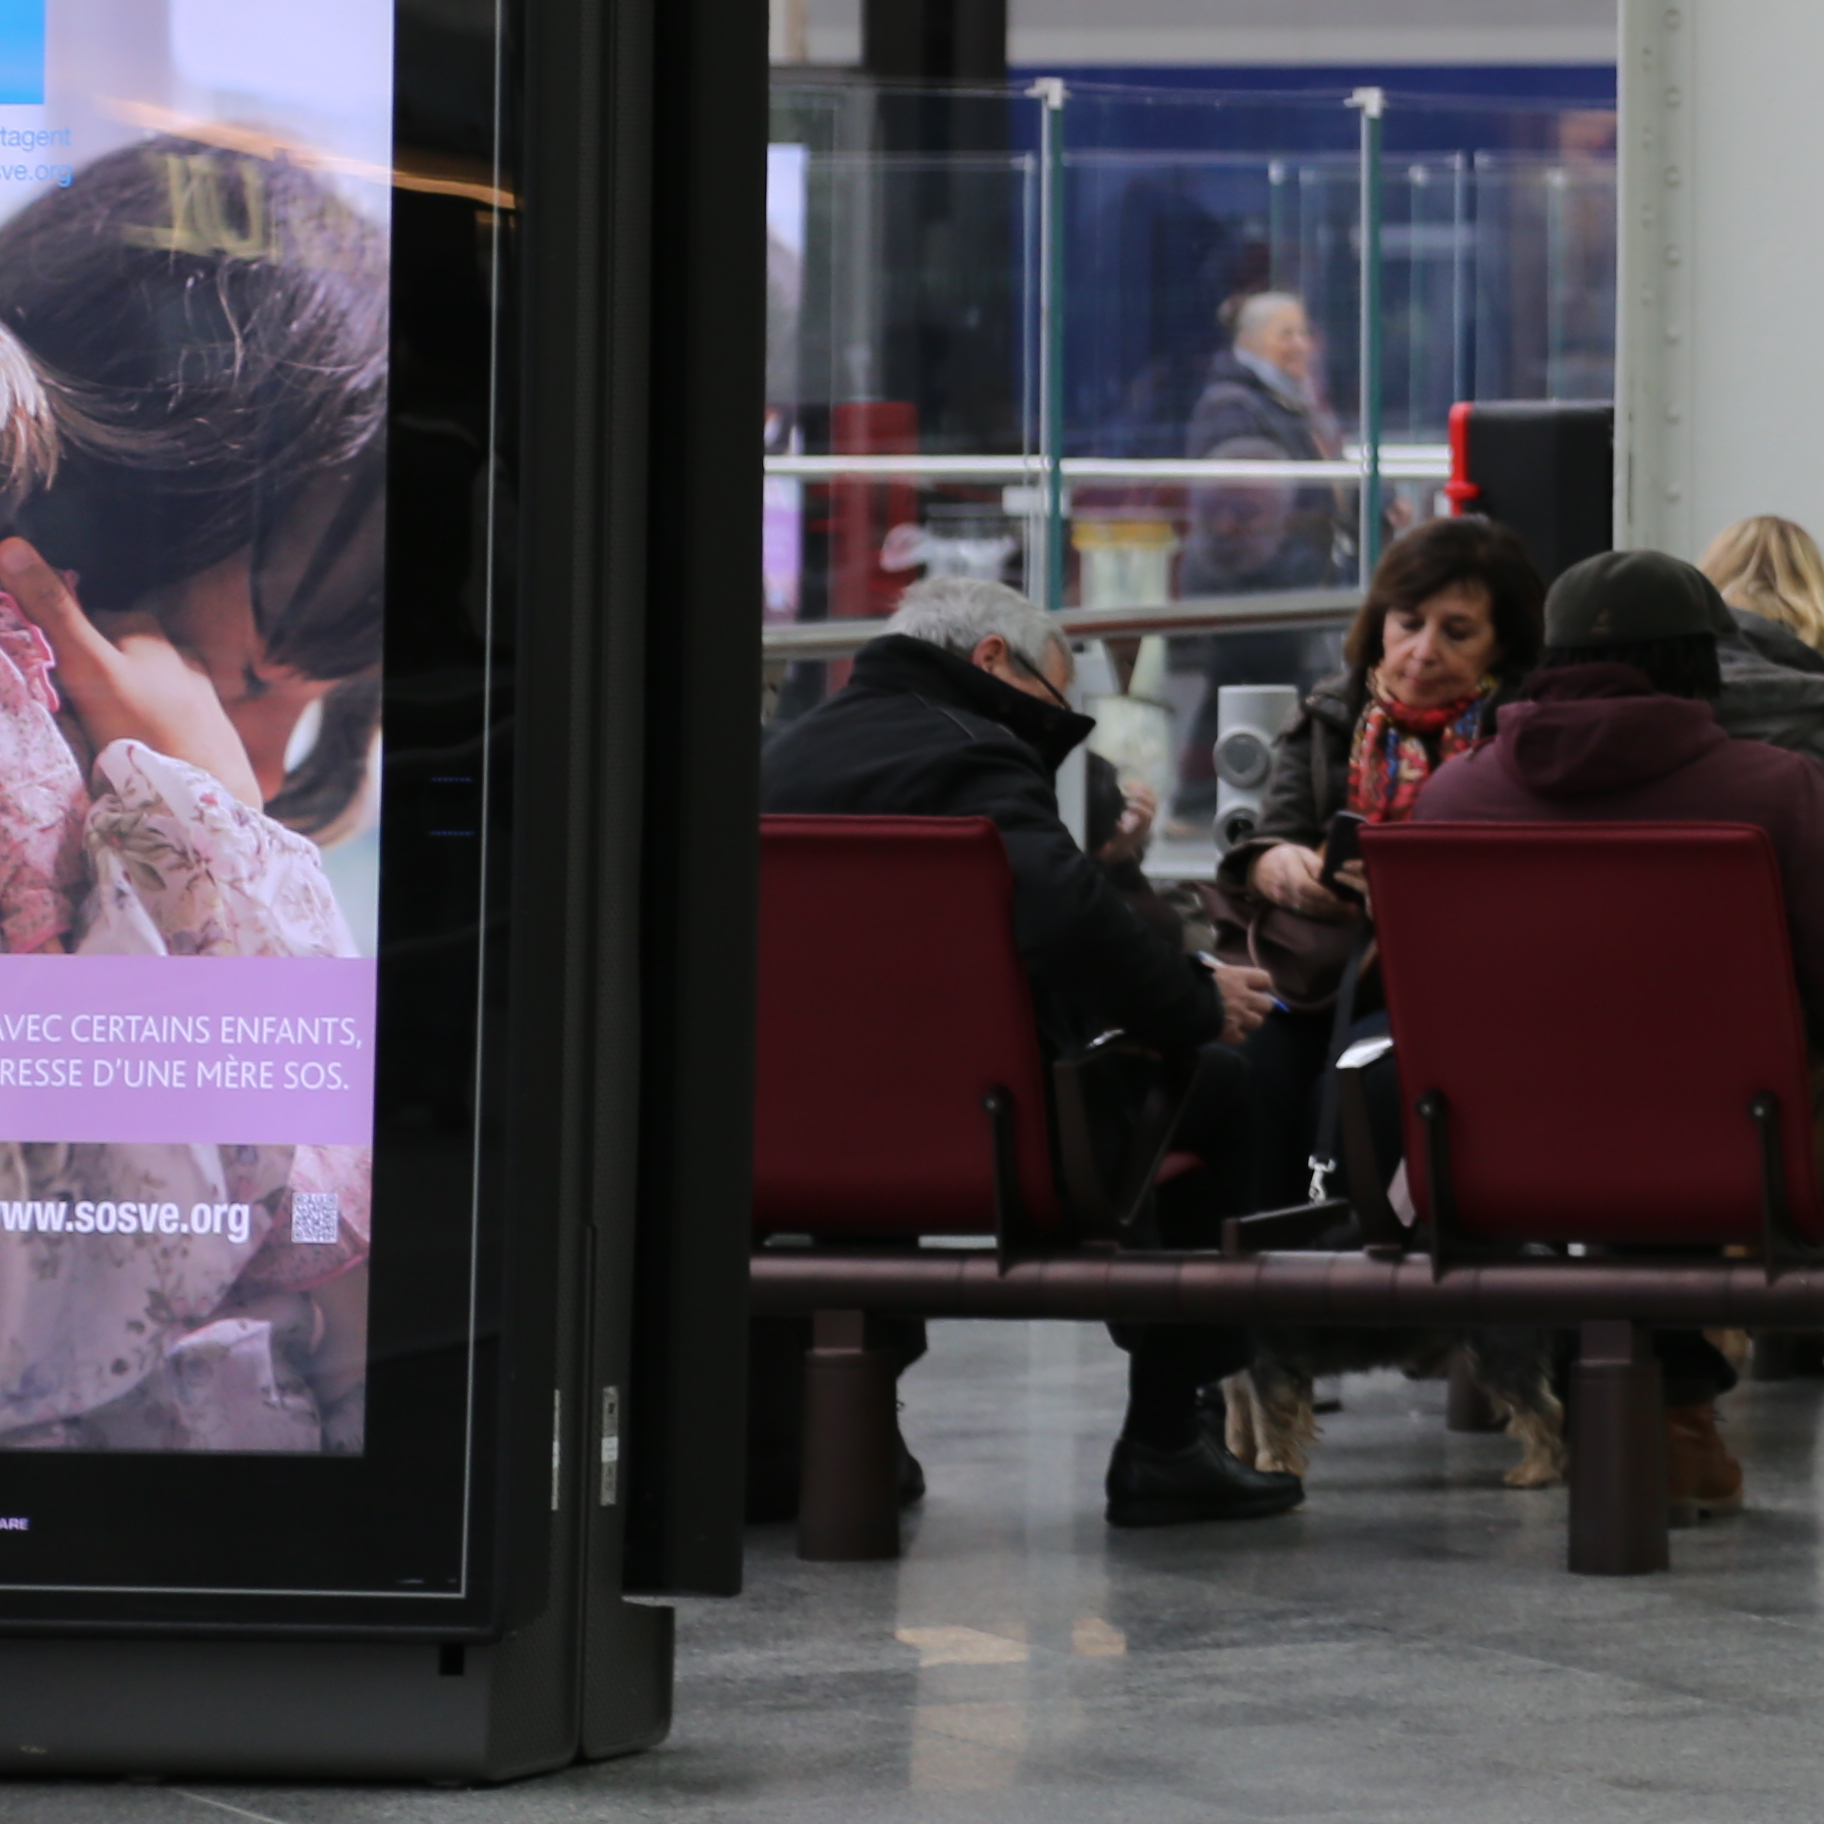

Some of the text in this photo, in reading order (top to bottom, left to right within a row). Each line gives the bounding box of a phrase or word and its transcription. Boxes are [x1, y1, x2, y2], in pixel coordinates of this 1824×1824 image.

[0, 162, 74, 188] ve.org
[0, 1013, 362, 1050] VEC CERTAINS ENFANTS,
[93, 1058, 187, 1088] D'UNE
[196, 1053, 275, 1089] MÈRE
[283, 1061, 350, 1090] SOS.
[0, 1200, 251, 1244] ww.sosve.org
